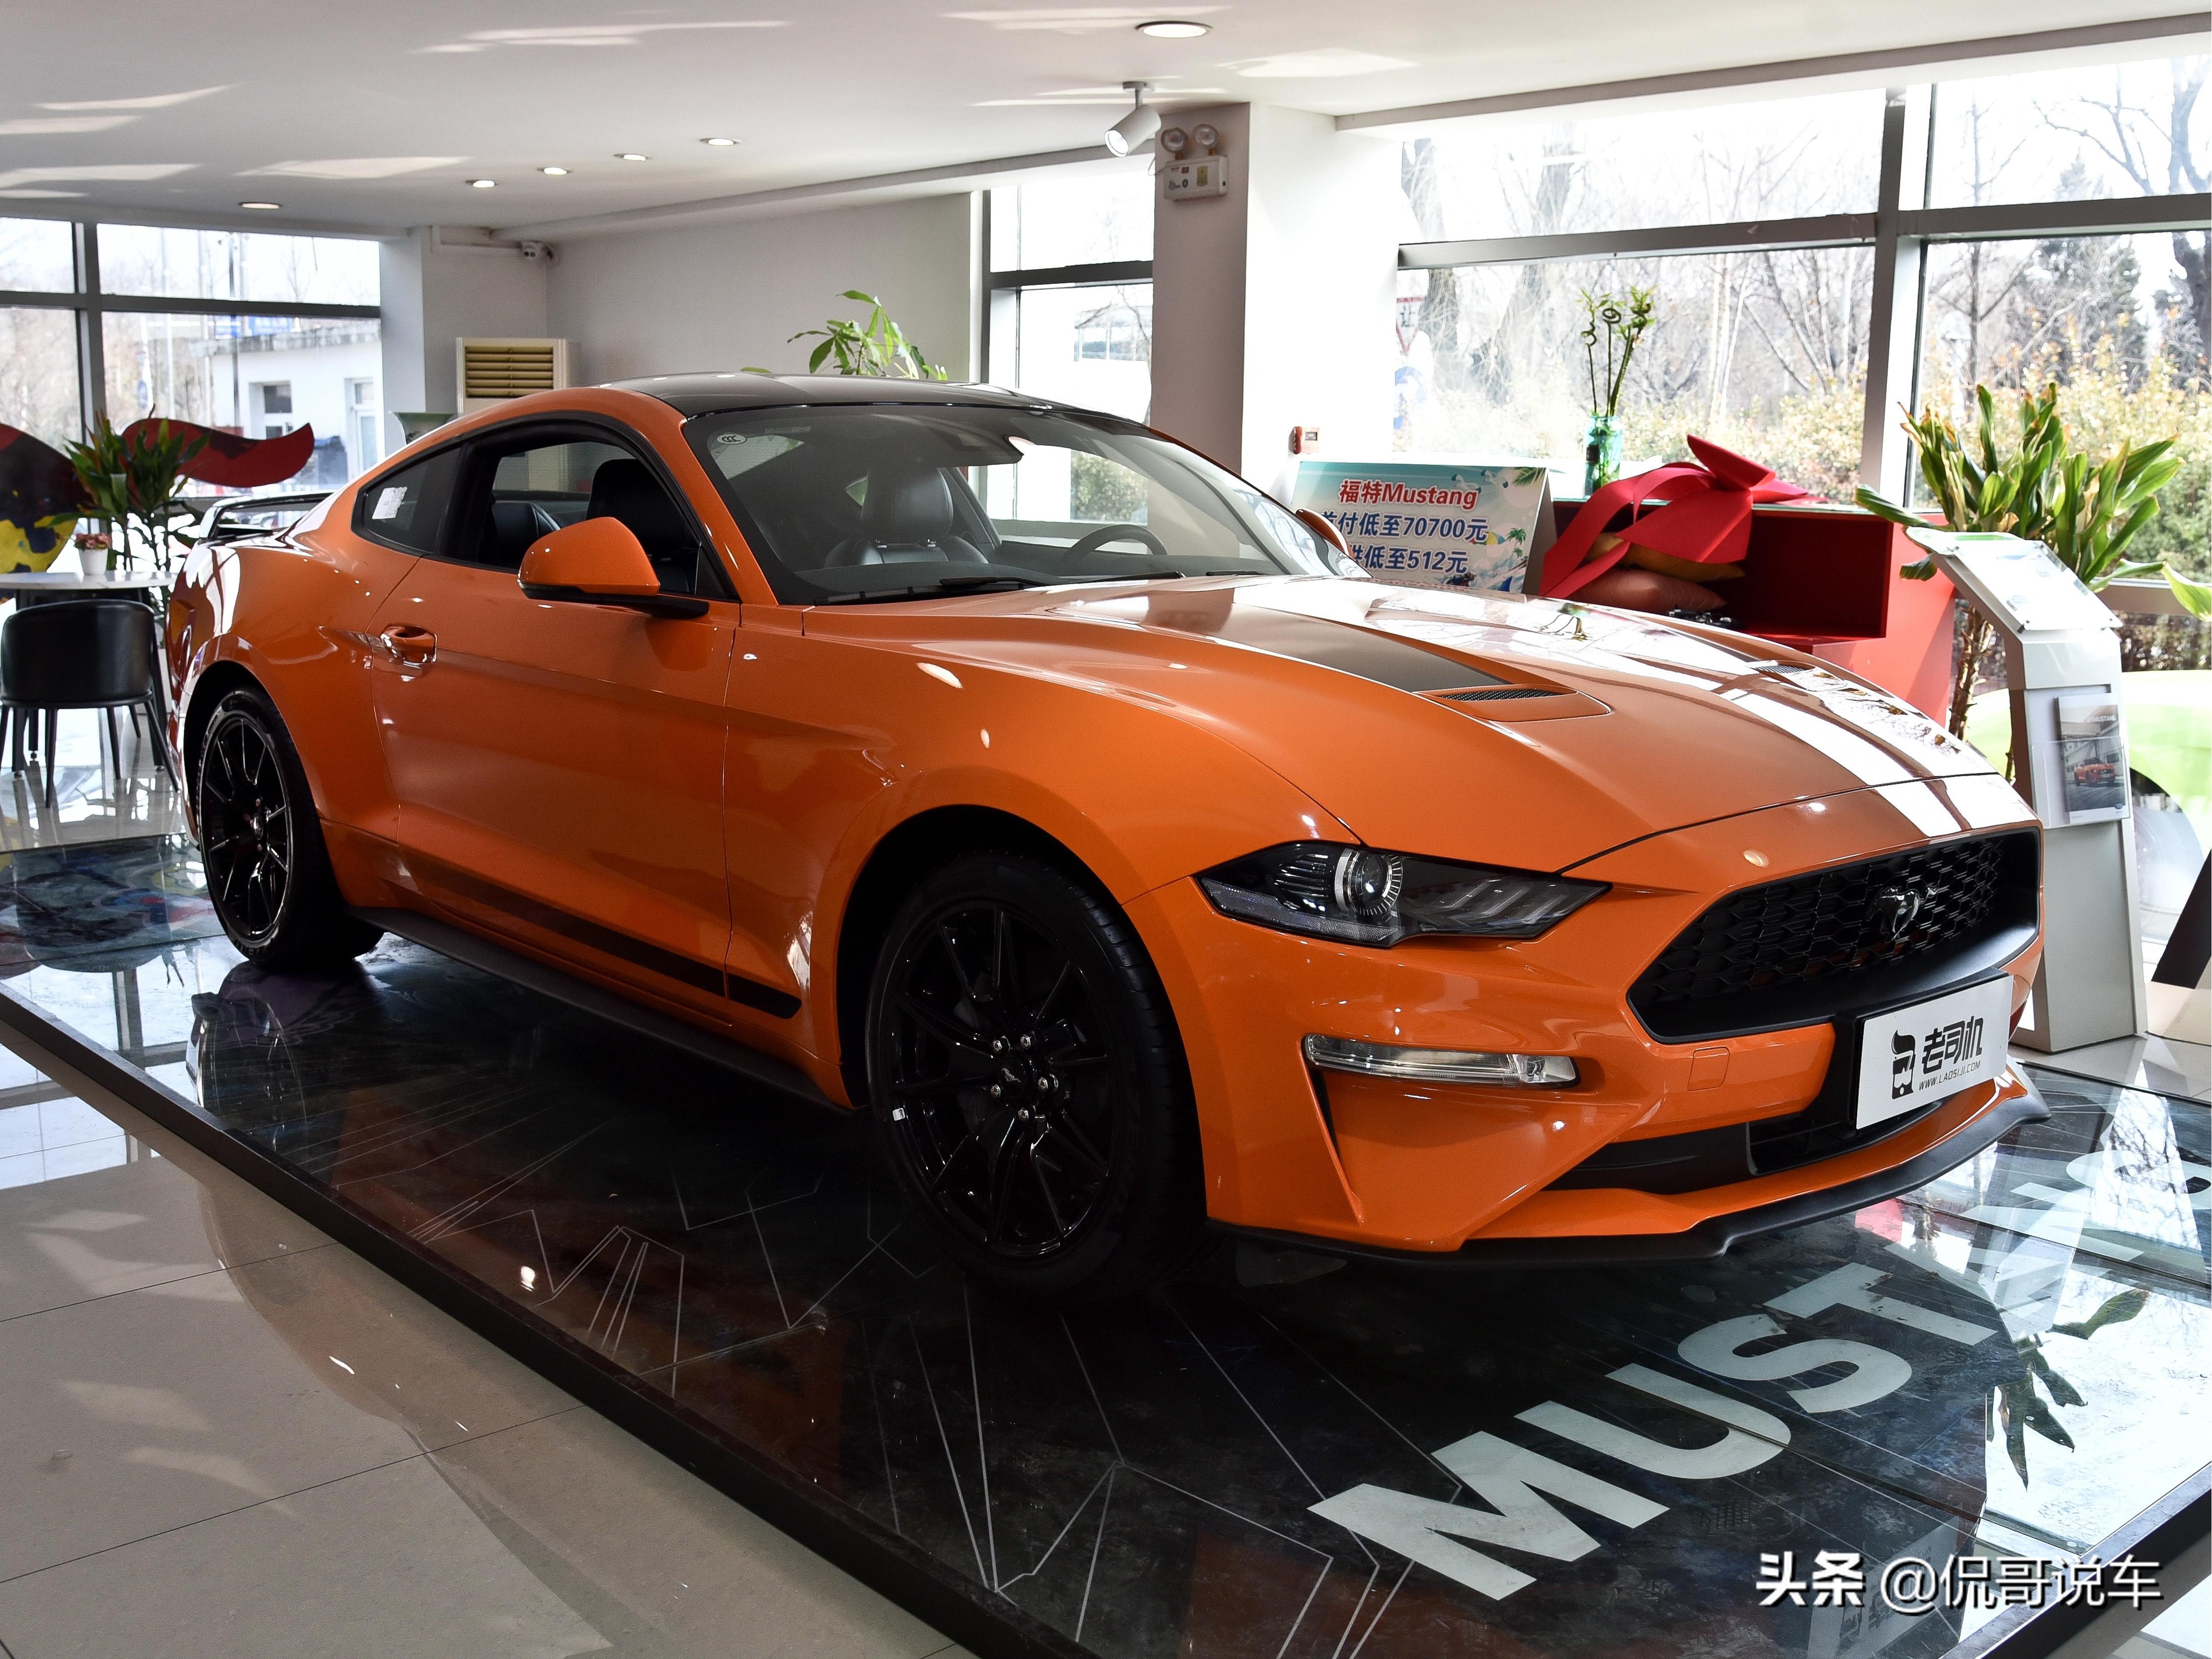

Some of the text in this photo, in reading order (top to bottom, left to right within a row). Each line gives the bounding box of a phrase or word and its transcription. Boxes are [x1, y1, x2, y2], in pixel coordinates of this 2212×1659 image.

[1339, 480, 1479, 510] 福特Mustang
[1921, 1016, 1984, 1074] 老司机
[1919, 1060, 1981, 1090] WWW.LAOSIJI.COM
